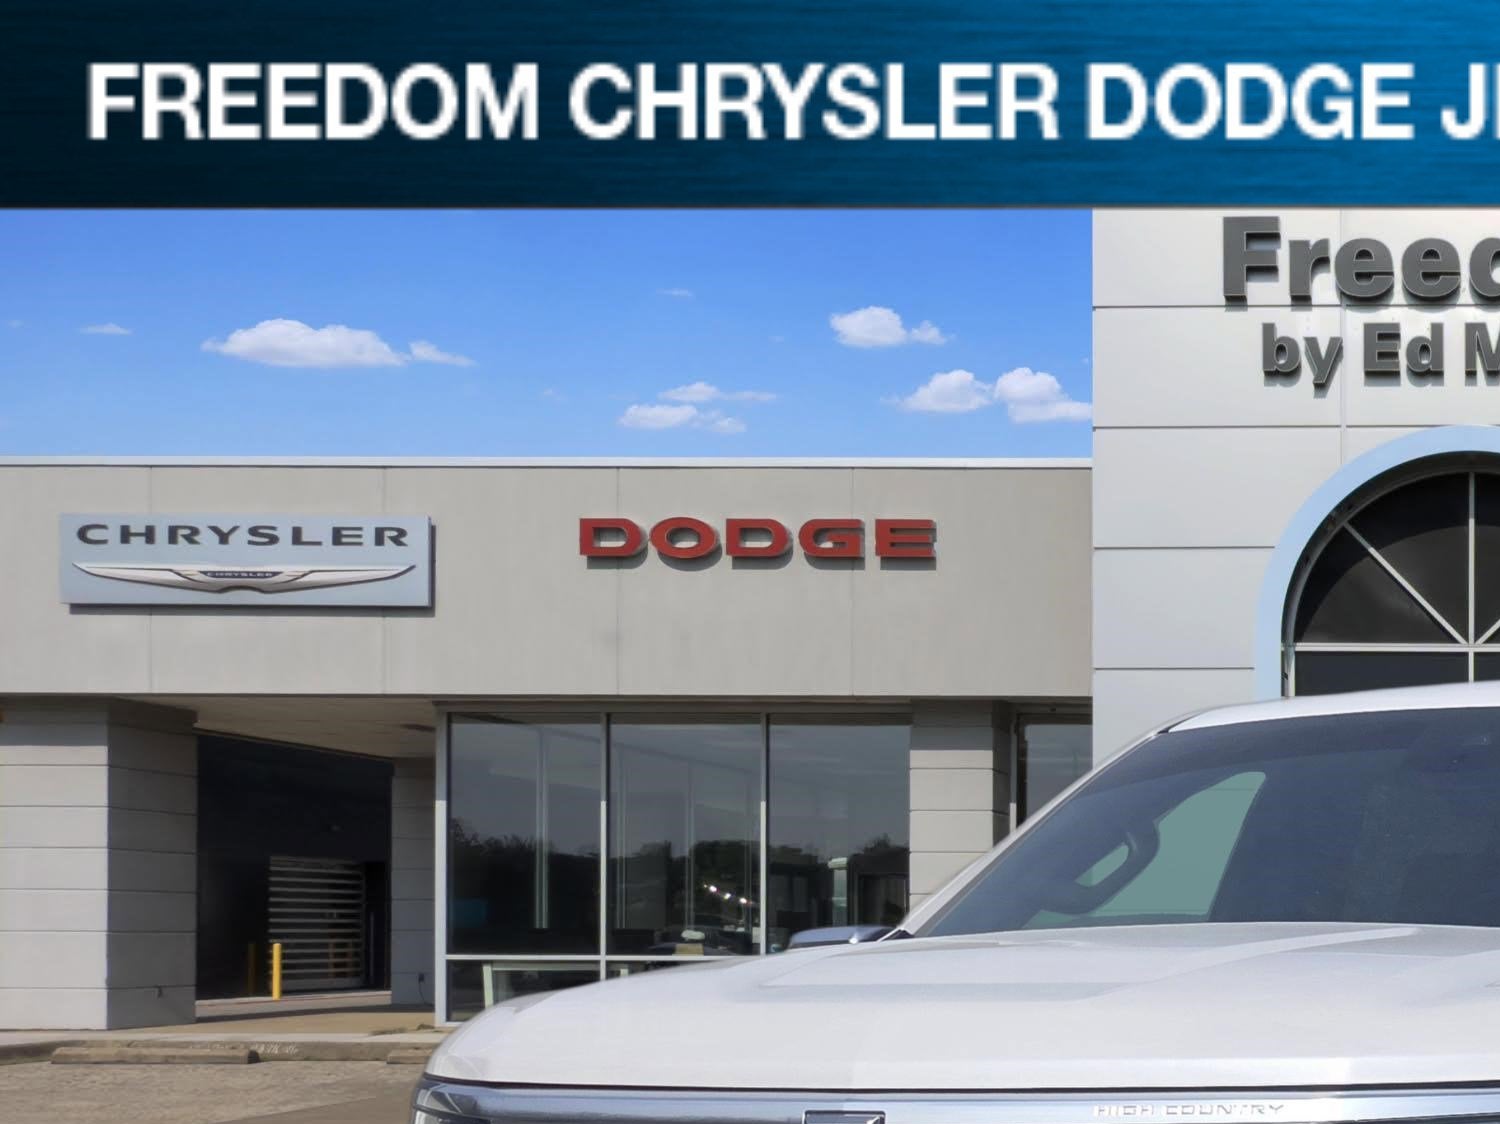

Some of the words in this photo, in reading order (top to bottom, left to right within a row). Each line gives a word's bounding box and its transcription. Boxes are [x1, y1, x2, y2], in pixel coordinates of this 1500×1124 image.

[1261, 322, 1344, 390] by
[1363, 322, 1445, 378] Ed
[75, 523, 409, 548] CHRYSLER
[578, 517, 936, 559] DODGE
[1094, 1103, 1155, 1117] HIGH
[1164, 1103, 1285, 1117] COUNTRY
